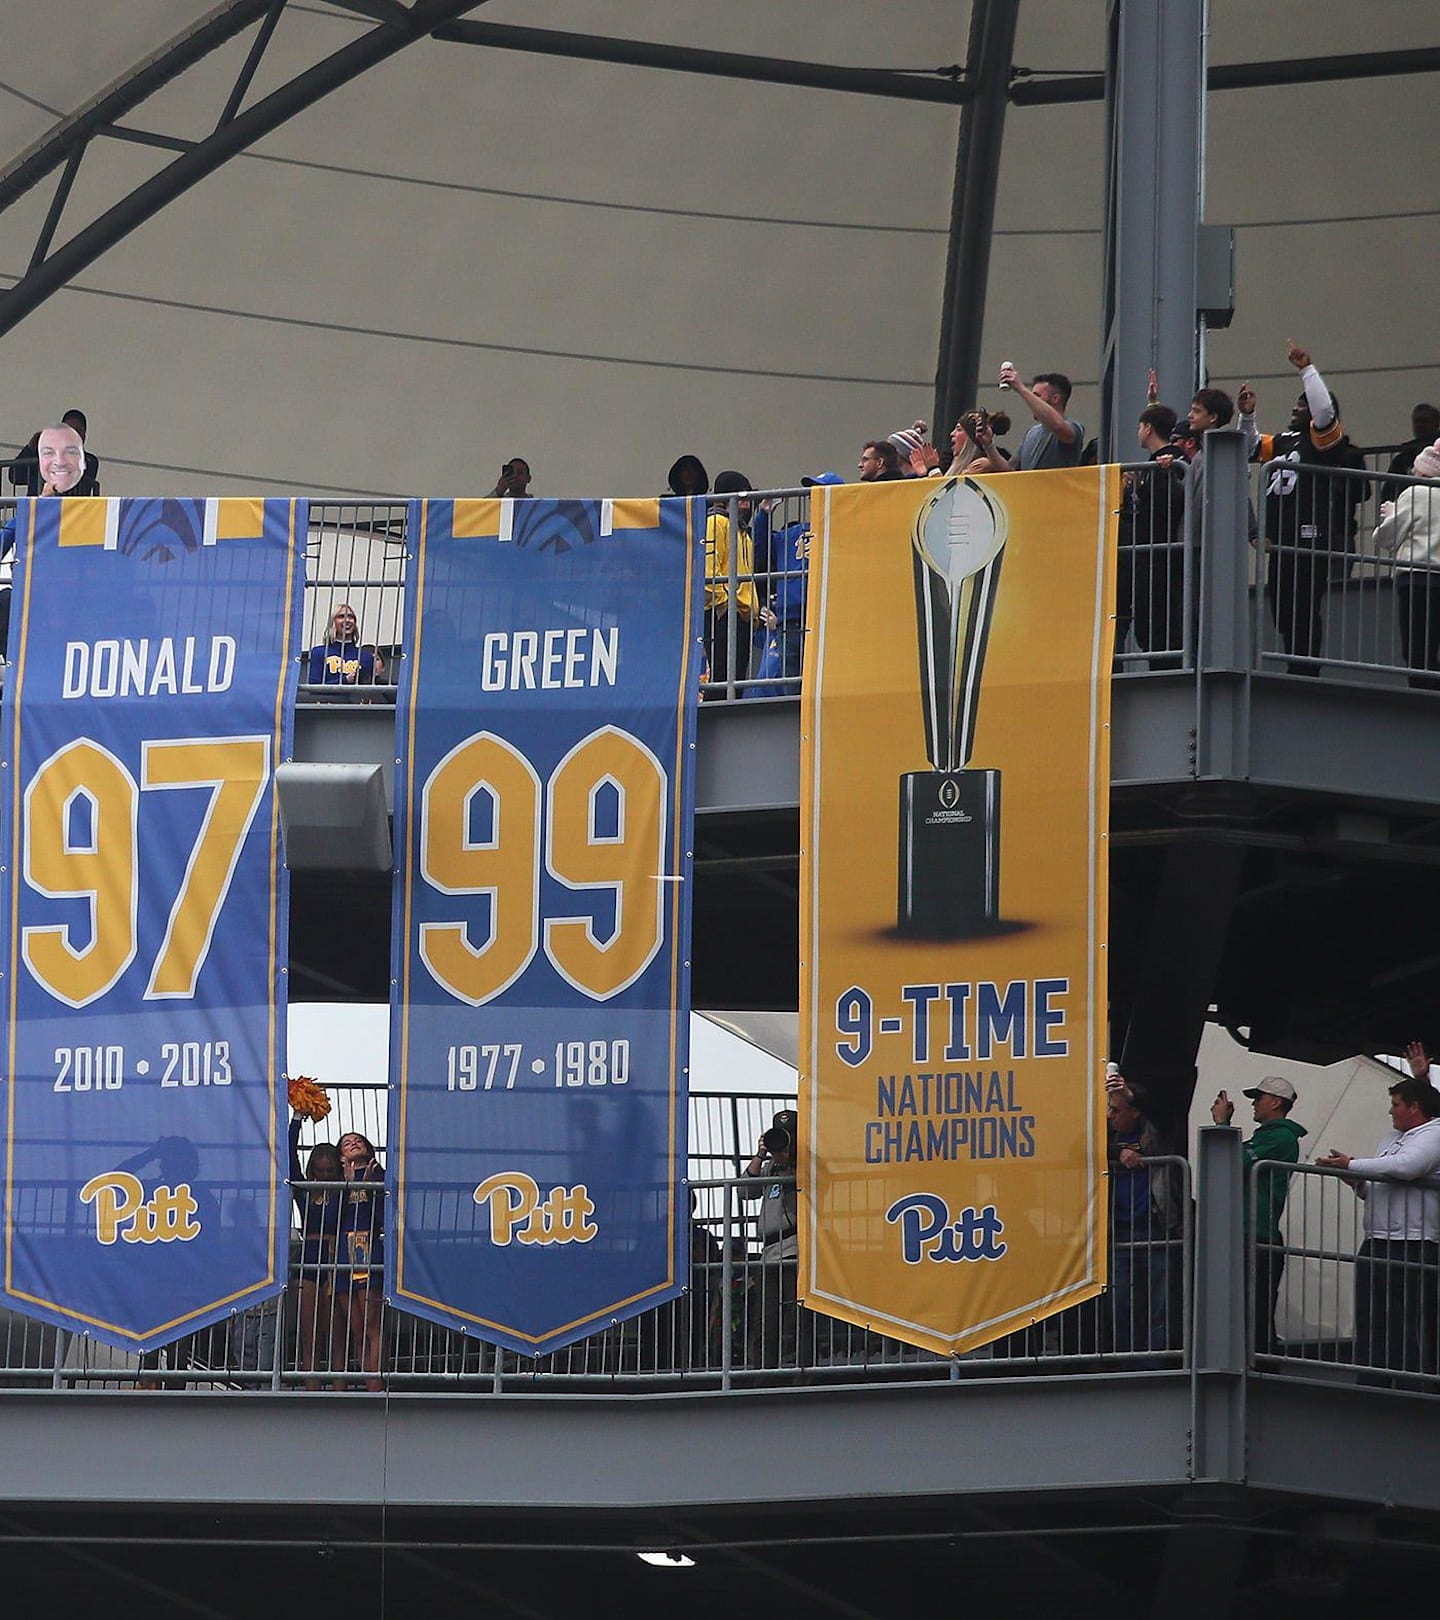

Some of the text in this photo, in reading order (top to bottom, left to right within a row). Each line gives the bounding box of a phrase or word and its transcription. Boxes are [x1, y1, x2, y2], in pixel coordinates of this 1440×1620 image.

[62, 636, 236, 698] DONALD
[482, 628, 618, 691] GREEN
[22, 735, 271, 1009] 97
[419, 724, 668, 1007] 99
[836, 977, 1069, 1067] 9-TIME
[54, 1041, 231, 1092] 2010 2013
[448, 1040, 629, 1090] 1977 1980
[877, 1071, 1022, 1117] NATIONAL
[865, 1116, 1035, 1163] CHAMPIONS
[79, 1171, 201, 1245] Pitt
[473, 1172, 598, 1246] Pitt
[886, 1193, 1007, 1264] Pitt
